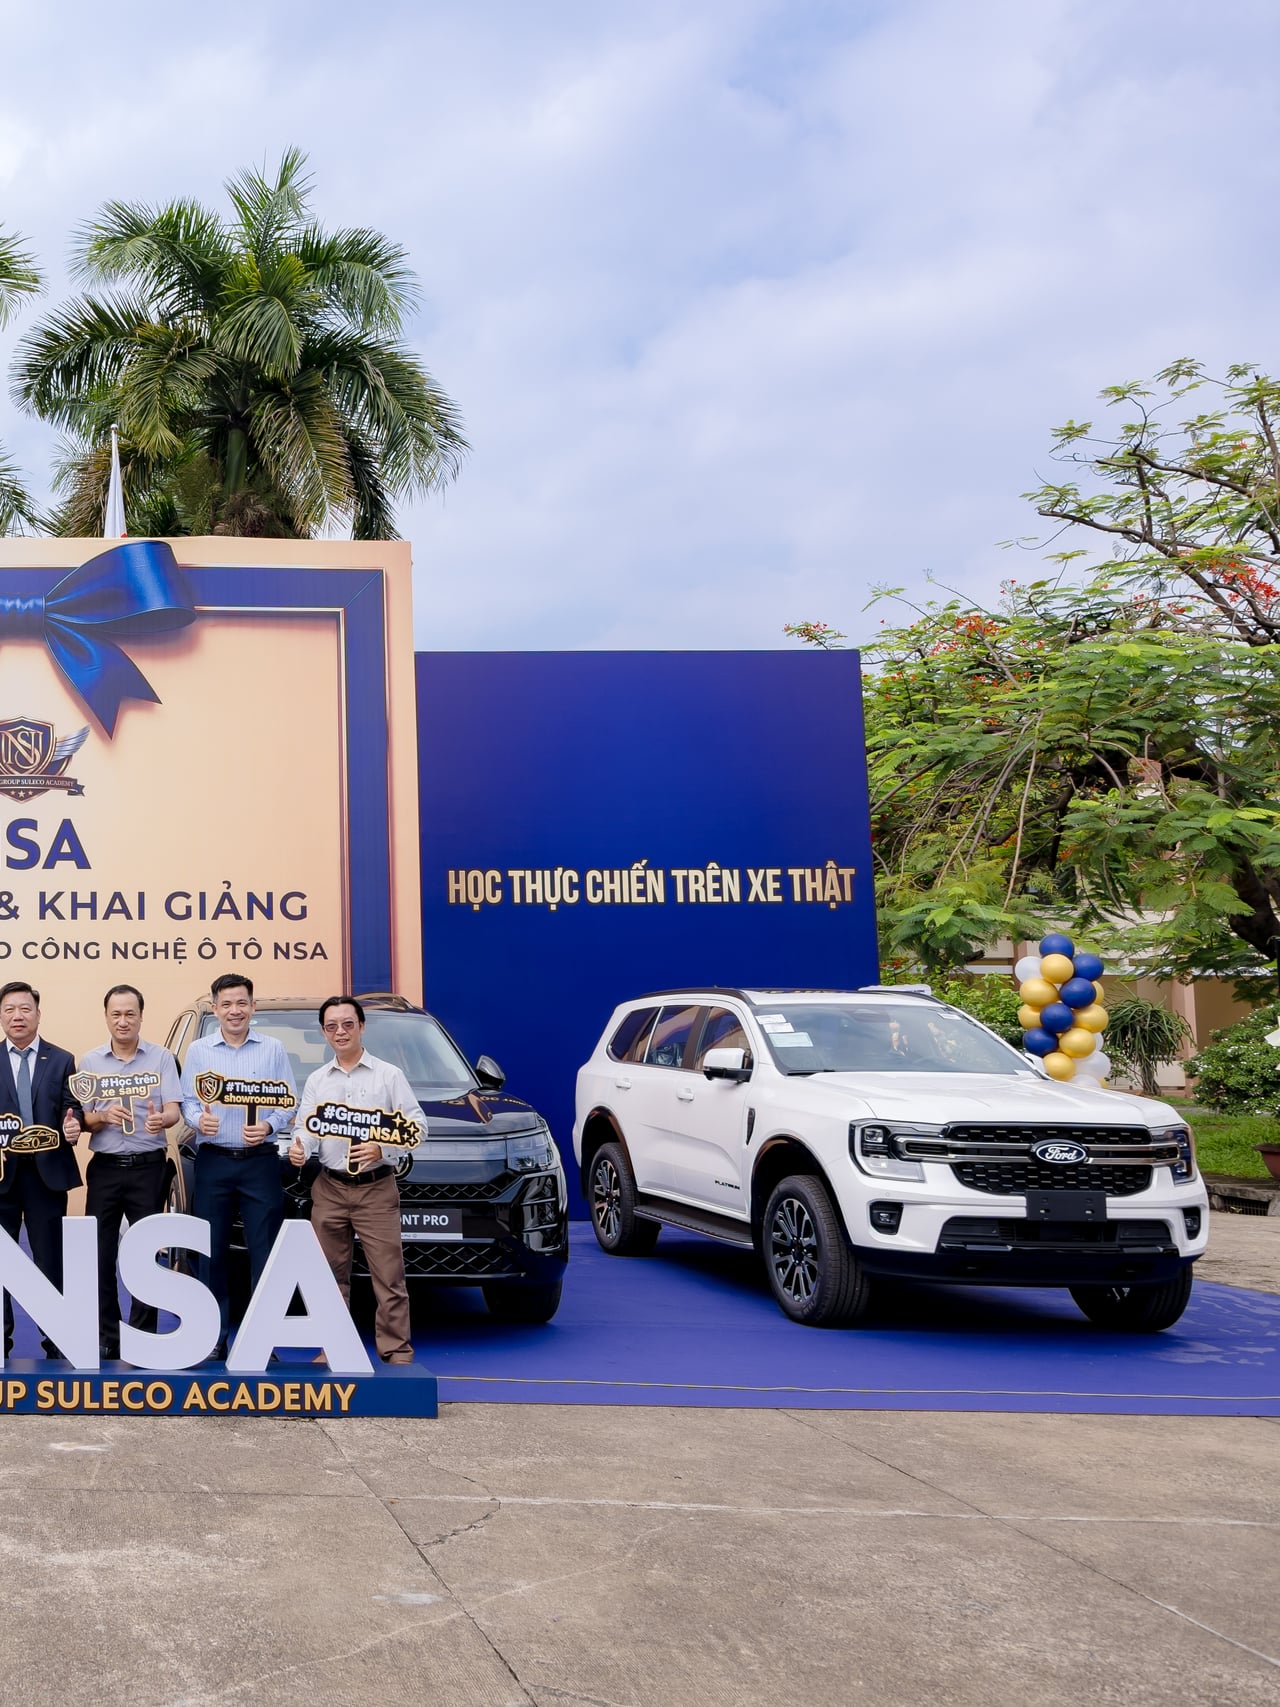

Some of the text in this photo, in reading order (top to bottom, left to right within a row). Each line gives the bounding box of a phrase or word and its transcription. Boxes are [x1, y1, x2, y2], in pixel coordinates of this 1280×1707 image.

[21, 778, 45, 786] SULECO
[45, 778, 74, 788] ACADEMY
[448, 859, 856, 911] HỌC THỰC CHIẾN TRÊN XE THẬT
[38, 891, 146, 921] KHAI
[164, 880, 308, 921] GIẢNG
[22, 937, 101, 960] CÔNG
[111, 937, 188, 964] NGHỆ
[197, 937, 217, 960] Ô
[226, 937, 263, 960] TÔ
[273, 942, 329, 960] NSA
[100, 1074, 157, 1088] #Học trên
[102, 1086, 146, 1097] xe sang
[226, 1082, 287, 1095] #Thực hành
[224, 1093, 293, 1107] showroom xịn
[323, 1105, 381, 1125] #Grand
[1045, 1146, 1077, 1160] Ford
[423, 1214, 449, 1226] PRO
[37, 1381, 173, 1410] SULECO
[183, 1382, 357, 1411] ACADEMY
